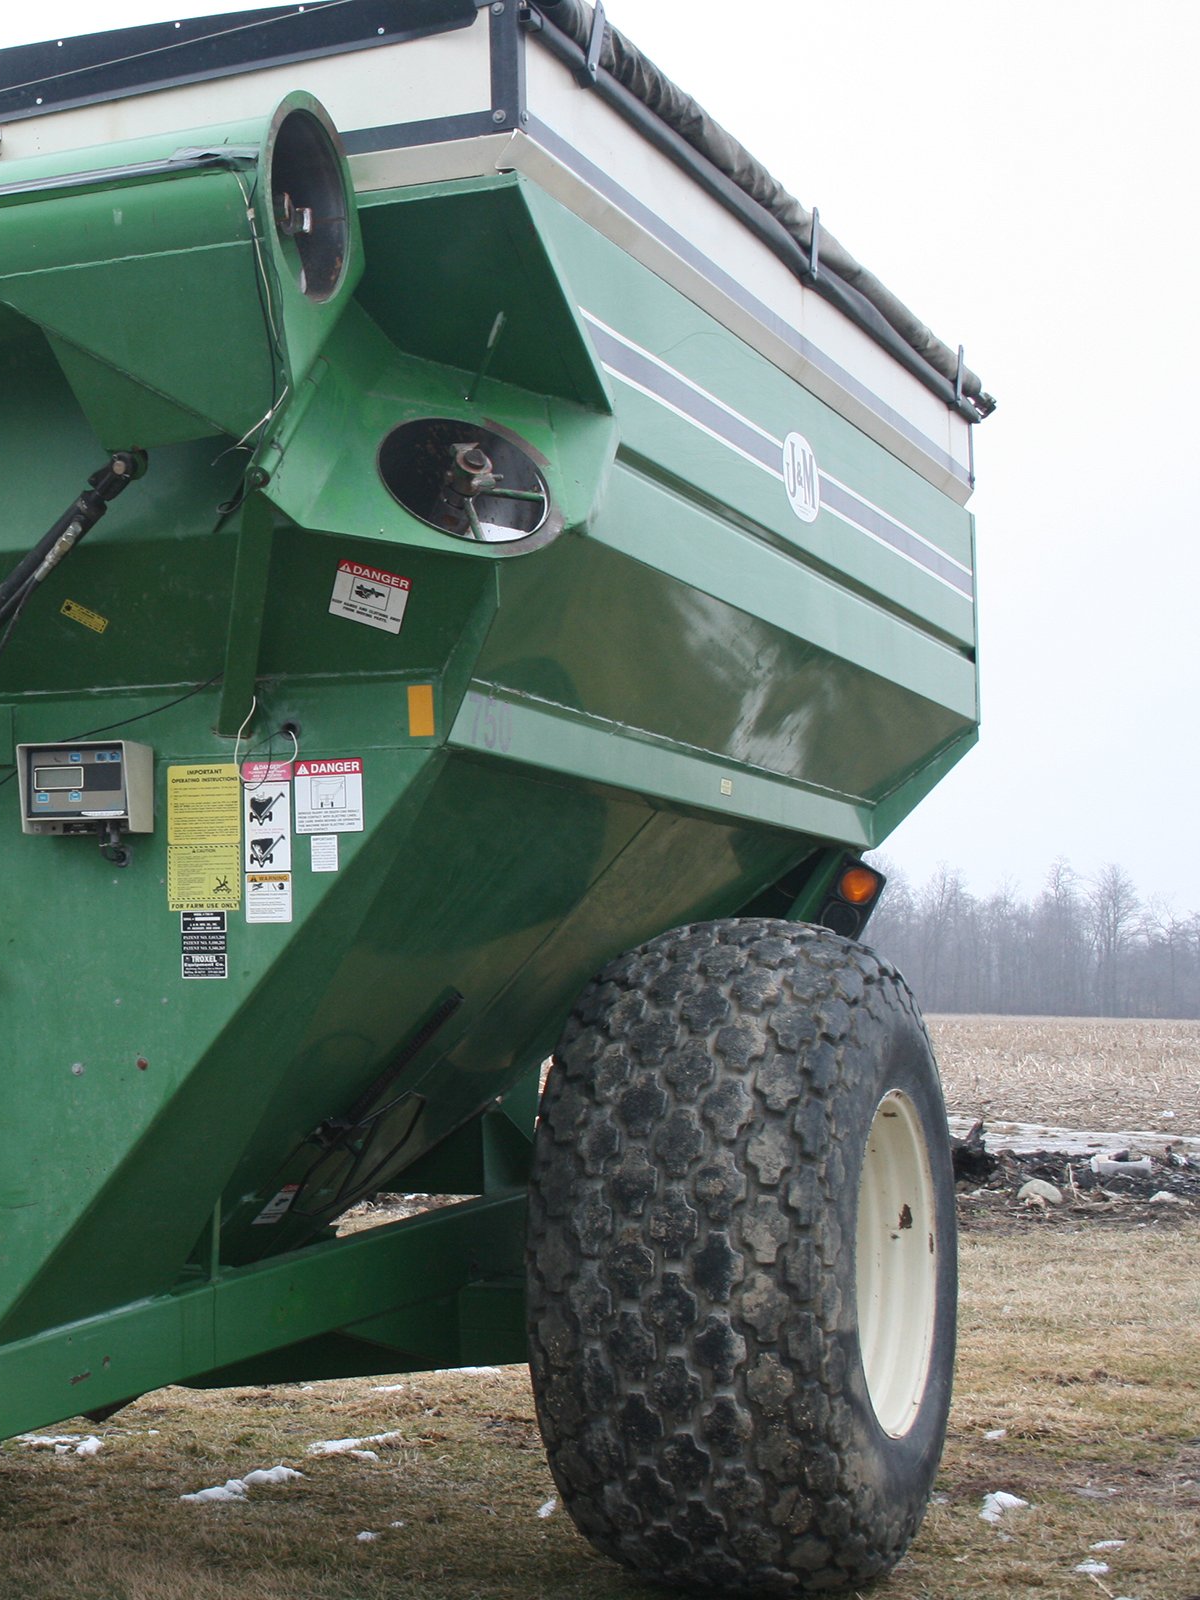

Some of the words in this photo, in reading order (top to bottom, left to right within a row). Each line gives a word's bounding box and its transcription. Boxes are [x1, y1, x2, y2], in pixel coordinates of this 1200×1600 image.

[786, 440, 816, 510] J&M
[352, 565, 410, 588] DANGER
[470, 694, 512, 752] 750
[310, 762, 360, 774] DANGER
